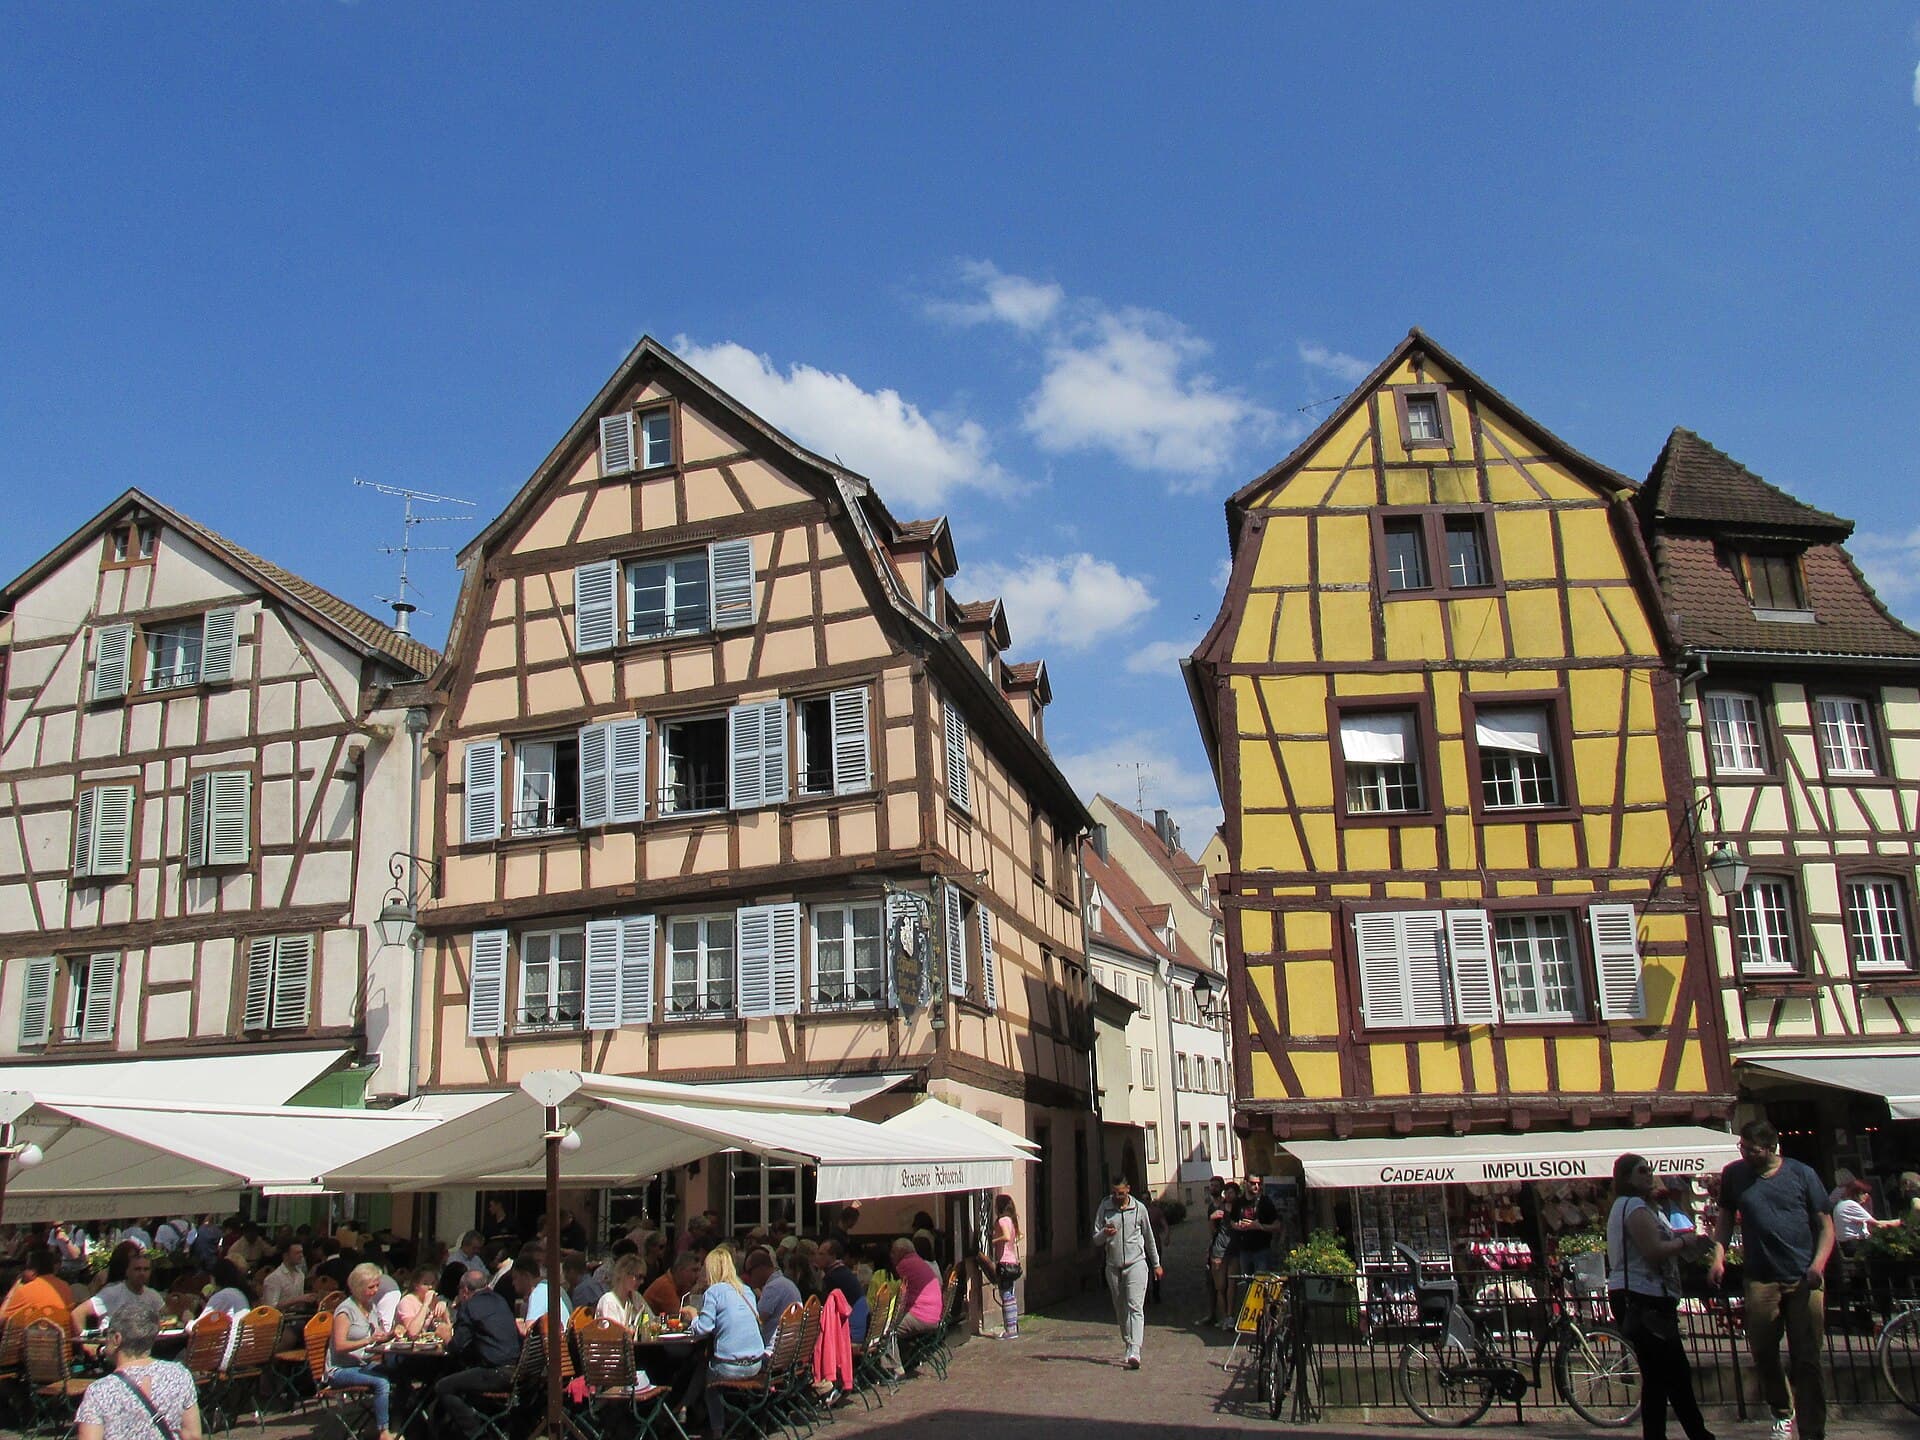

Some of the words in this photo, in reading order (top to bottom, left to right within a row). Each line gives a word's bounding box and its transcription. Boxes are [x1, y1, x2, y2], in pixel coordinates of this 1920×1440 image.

[901, 1167, 931, 1188] Brasserie
[1380, 1166, 1456, 1182] CADEAUX
[1482, 1159, 1587, 1179] IMPULSION
[1647, 1157, 1705, 1173] VENIRS
